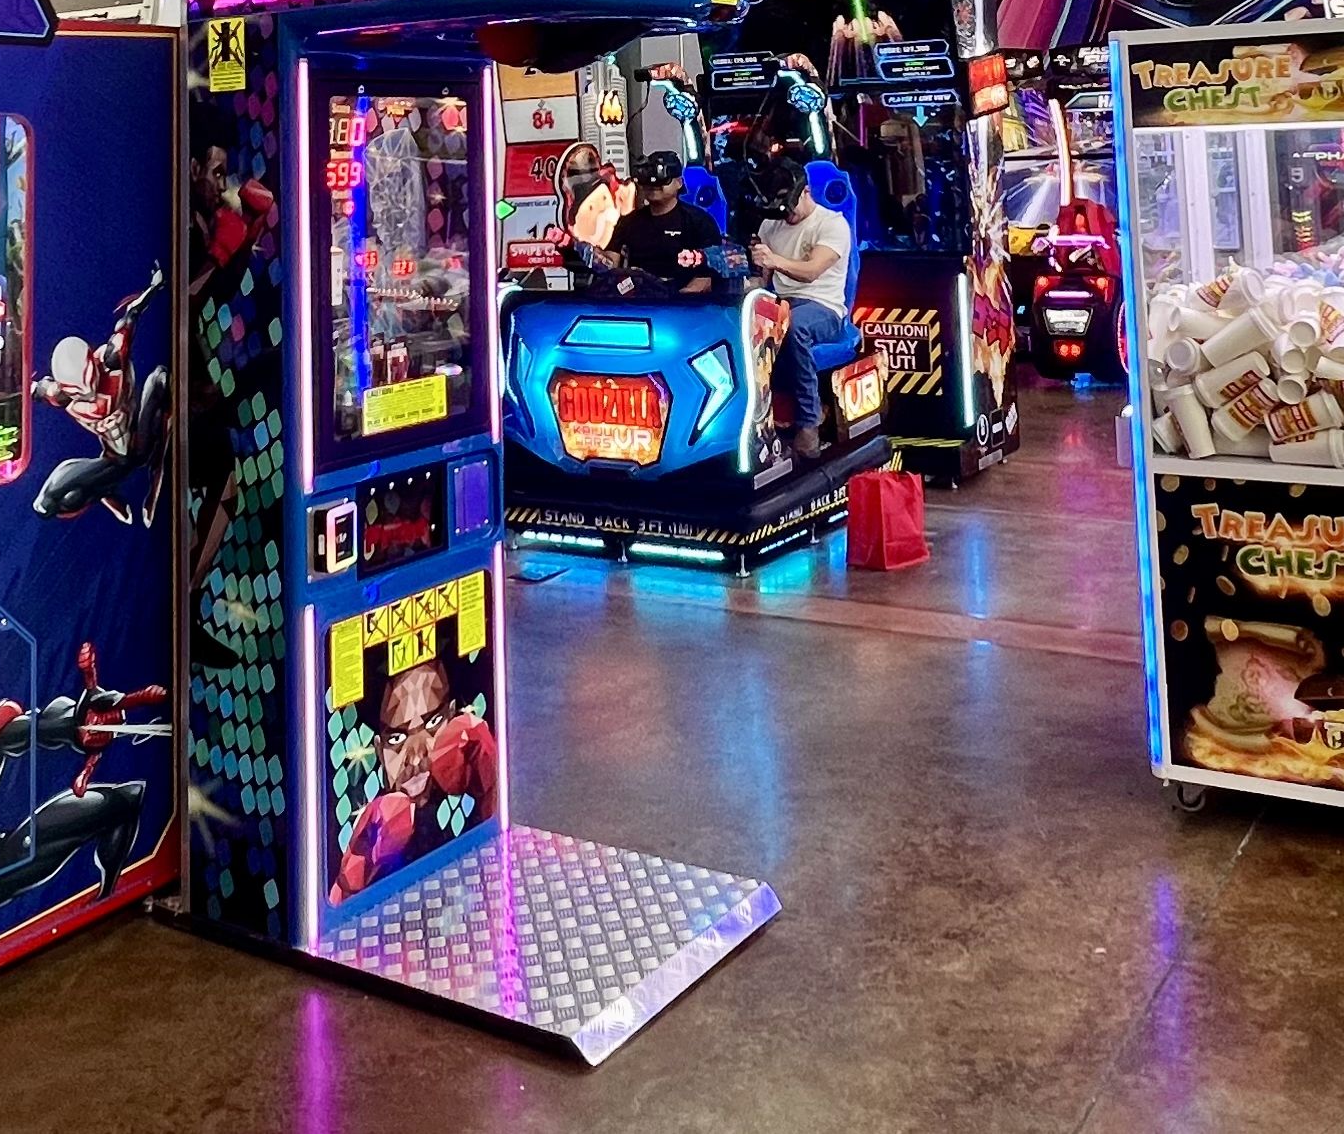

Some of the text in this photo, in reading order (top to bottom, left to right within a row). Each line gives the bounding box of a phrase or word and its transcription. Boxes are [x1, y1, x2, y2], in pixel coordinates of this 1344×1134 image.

[1131, 53, 1294, 89] TREASURE
[1163, 85, 1262, 112] CHEST
[532, 109, 555, 131] 84
[864, 322, 929, 338] CAUTION!
[873, 338, 918, 355] STAY
[888, 354, 917, 371] UT!
[844, 368, 881, 418] VR
[559, 385, 663, 429] GODZILLA
[573, 424, 654, 453] KAIJU VR
[544, 508, 585, 525] STAND
[594, 516, 630, 530] BACK
